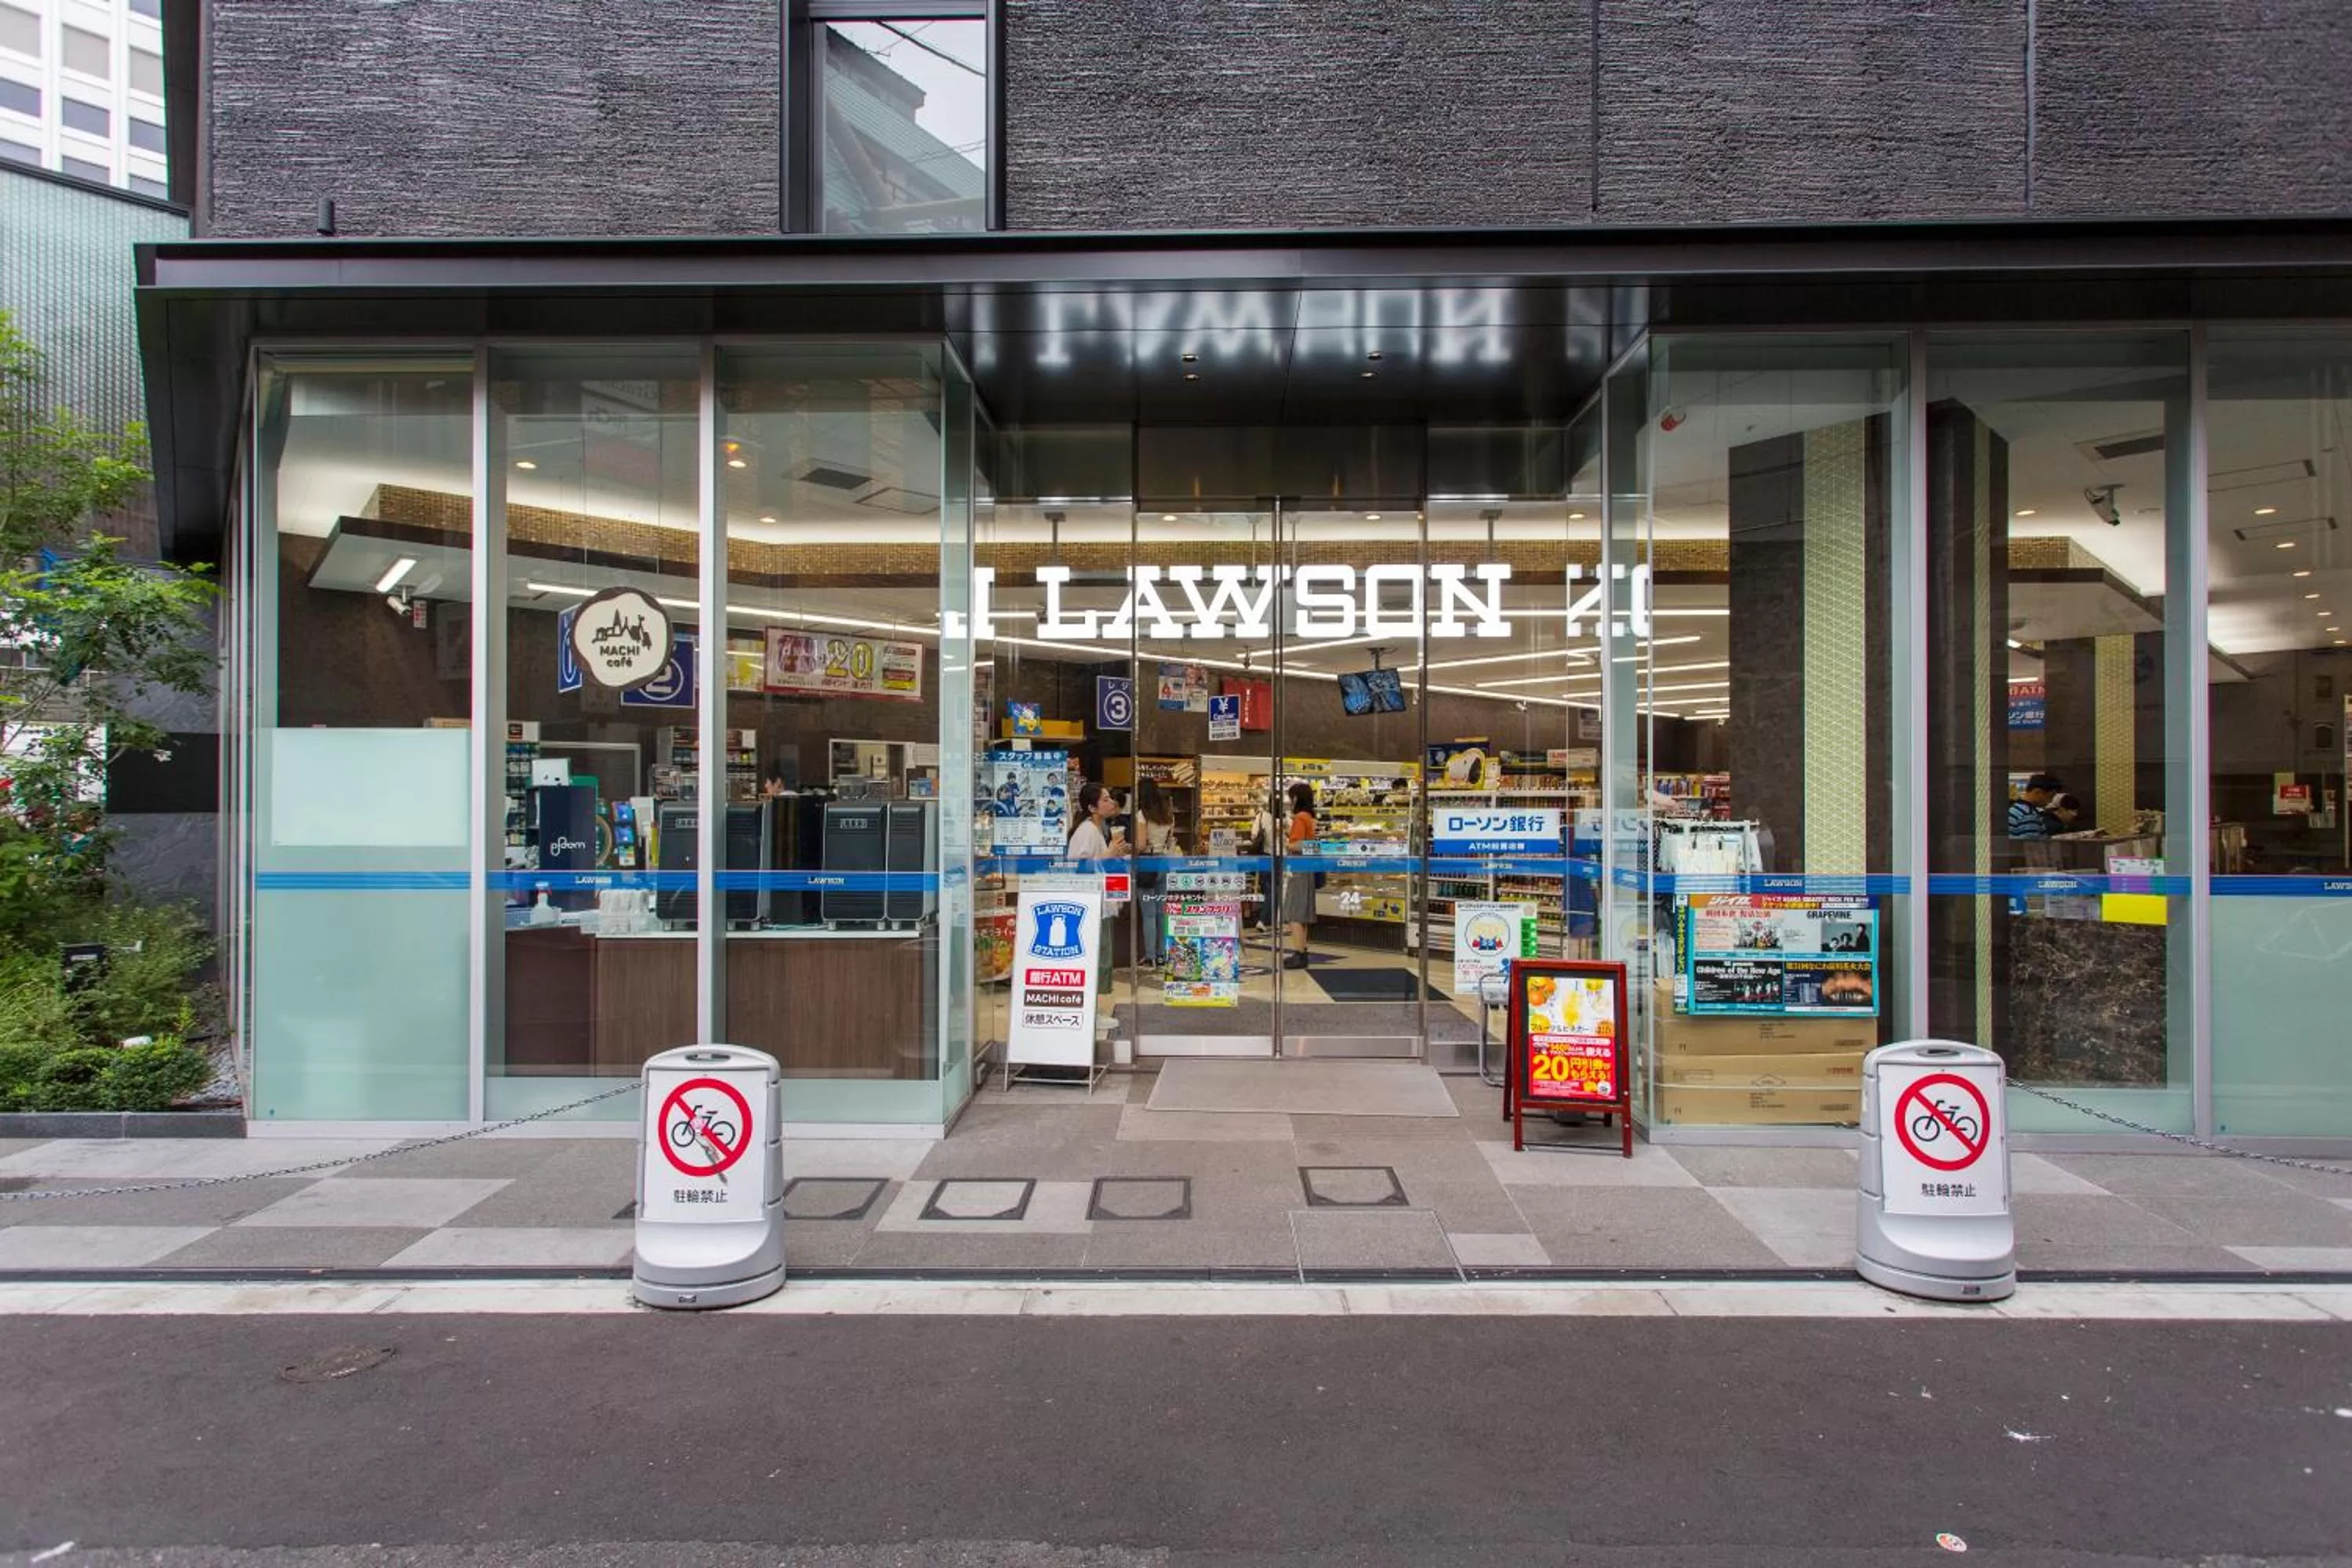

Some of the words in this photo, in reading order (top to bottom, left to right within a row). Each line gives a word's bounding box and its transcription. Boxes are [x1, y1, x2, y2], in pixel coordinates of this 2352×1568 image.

[1036, 564, 1512, 638] LAWSON
[600, 645, 640, 655] MACHI
[606, 657, 633, 667] café
[1111, 696, 1127, 720] 3
[999, 751, 1062, 760] スタッフ募集中
[1448, 816, 1544, 832] ローソン銀行
[1036, 903, 1083, 916] LAWSON
[1806, 910, 1852, 919] GRAPEVINE
[1034, 945, 1080, 957] STATION
[1029, 971, 1081, 984] 銀行ATM
[1026, 993, 1059, 1003] MACHI
[1060, 993, 1081, 1004] café
[1025, 1014, 1080, 1026] 休憩スペース
[1533, 1054, 1569, 1082] 20
[673, 1189, 728, 1203] 駐輪禁止
[1922, 1183, 1976, 1197] 駐輪禁止
